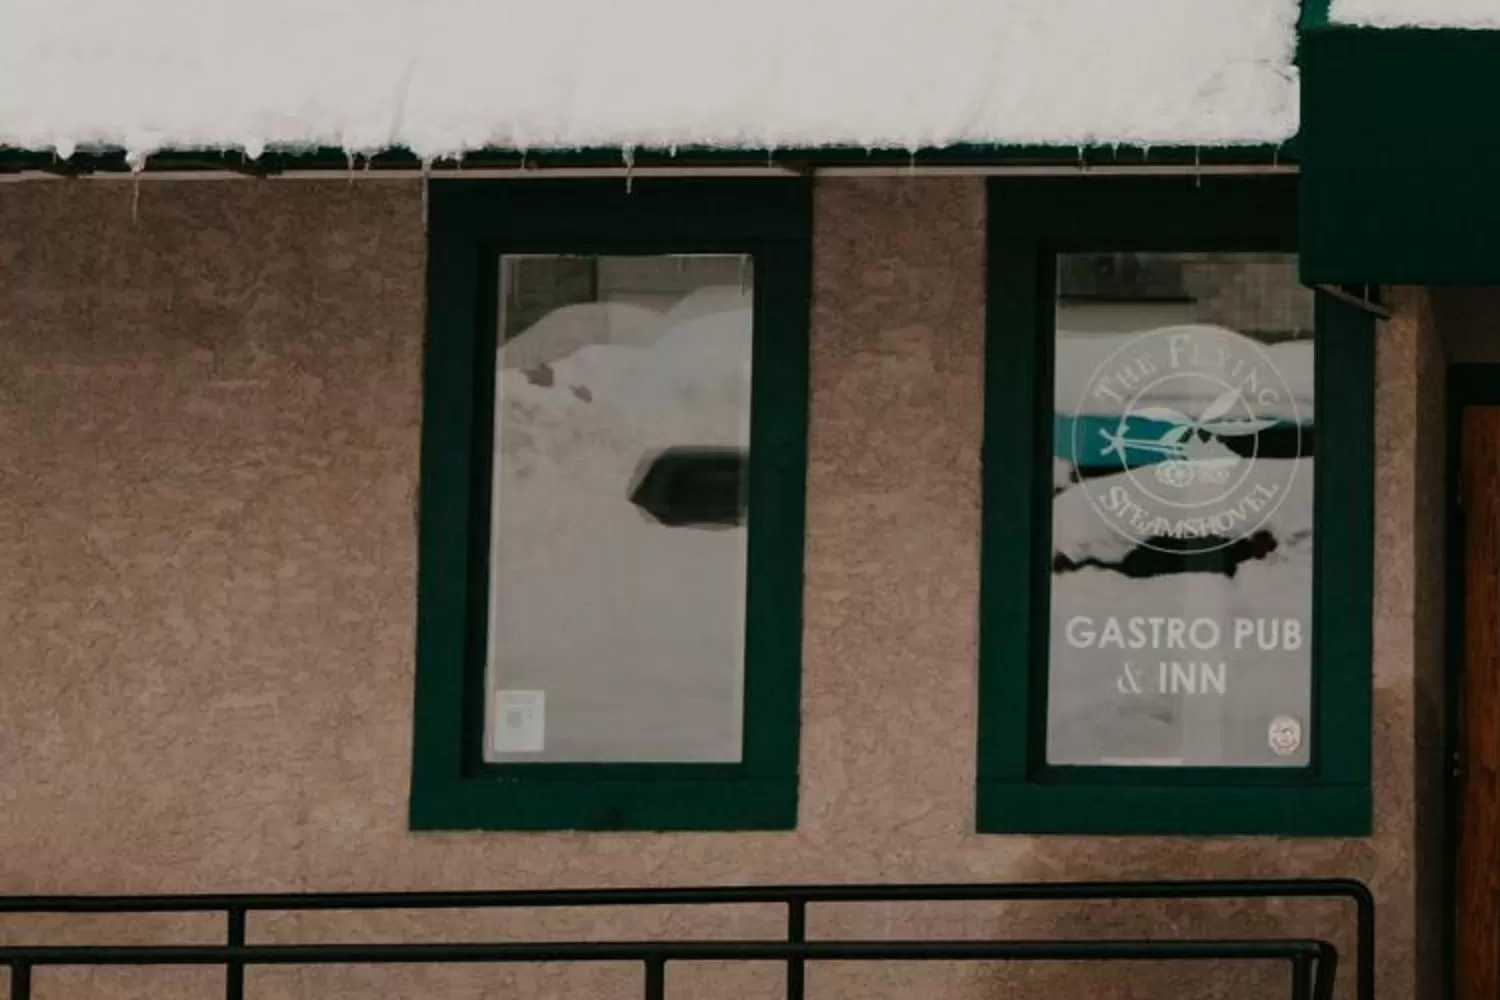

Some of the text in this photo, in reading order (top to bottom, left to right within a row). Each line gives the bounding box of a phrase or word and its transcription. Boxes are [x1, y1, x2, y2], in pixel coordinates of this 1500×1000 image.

[1101, 483, 1280, 538] STEAMSHOVEL
[1065, 615, 1302, 651] GASTRO PUB
[1116, 661, 1227, 695] & INN
